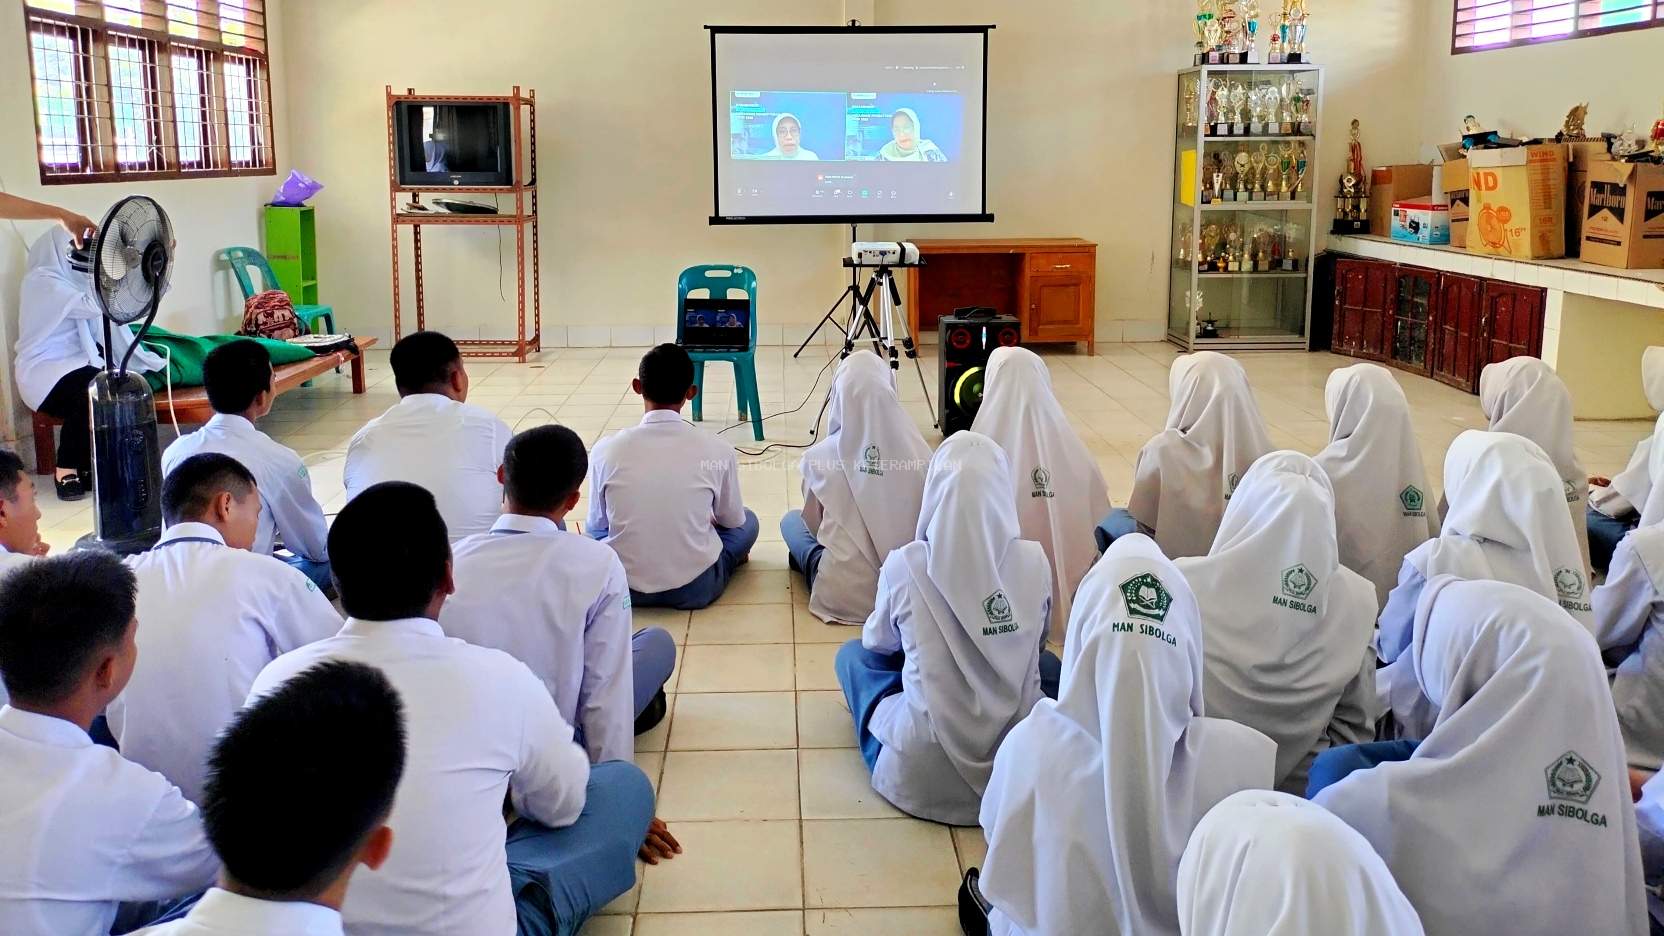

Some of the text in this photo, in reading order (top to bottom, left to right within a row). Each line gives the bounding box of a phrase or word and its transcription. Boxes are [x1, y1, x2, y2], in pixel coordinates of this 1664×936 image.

[1272, 595, 1317, 614] MAN SIBOLGA
[982, 626, 998, 636] MAN
[1112, 622, 1177, 647] MAN SIBOLGA
[1536, 804, 1608, 828] MAN SIBOLGA
